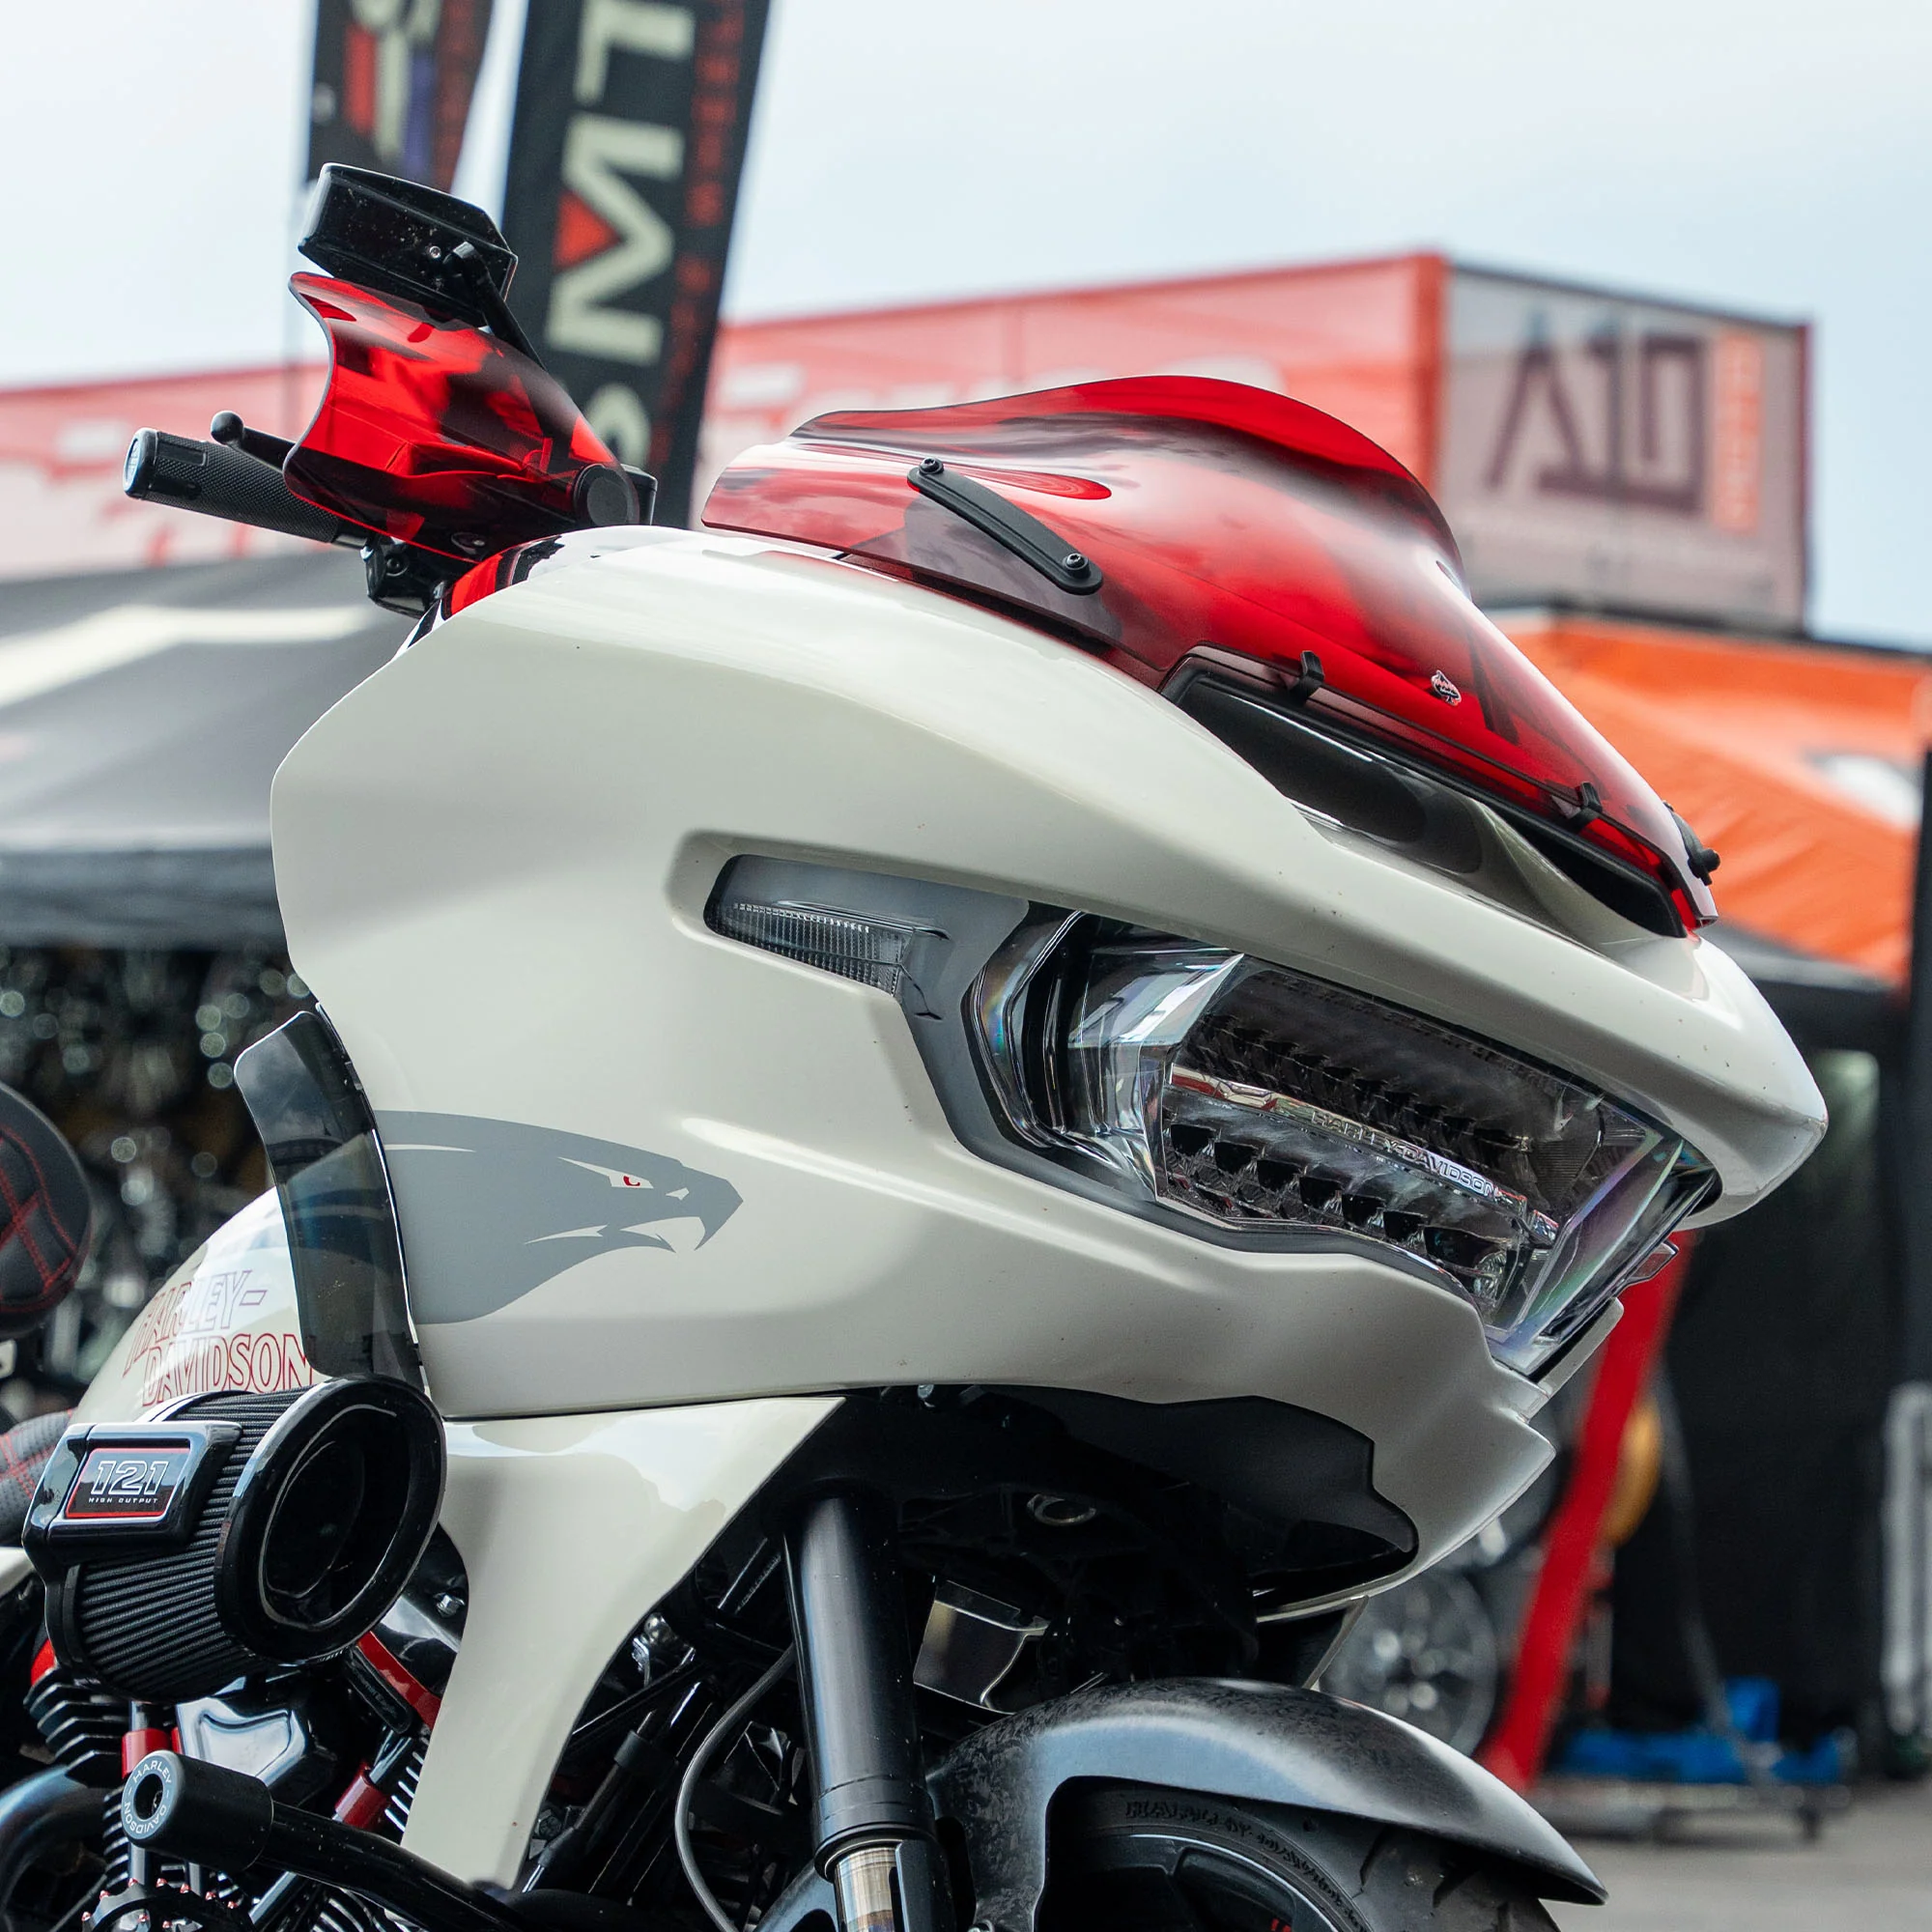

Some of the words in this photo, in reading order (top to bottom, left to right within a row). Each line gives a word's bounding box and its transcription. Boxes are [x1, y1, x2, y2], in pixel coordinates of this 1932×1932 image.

[142, 1333, 314, 1406] DAVIDSON
[91, 1461, 169, 1495] 121
[133, 1760, 171, 1783] HARLEY
[125, 1802, 166, 1833] DAVIDSON
